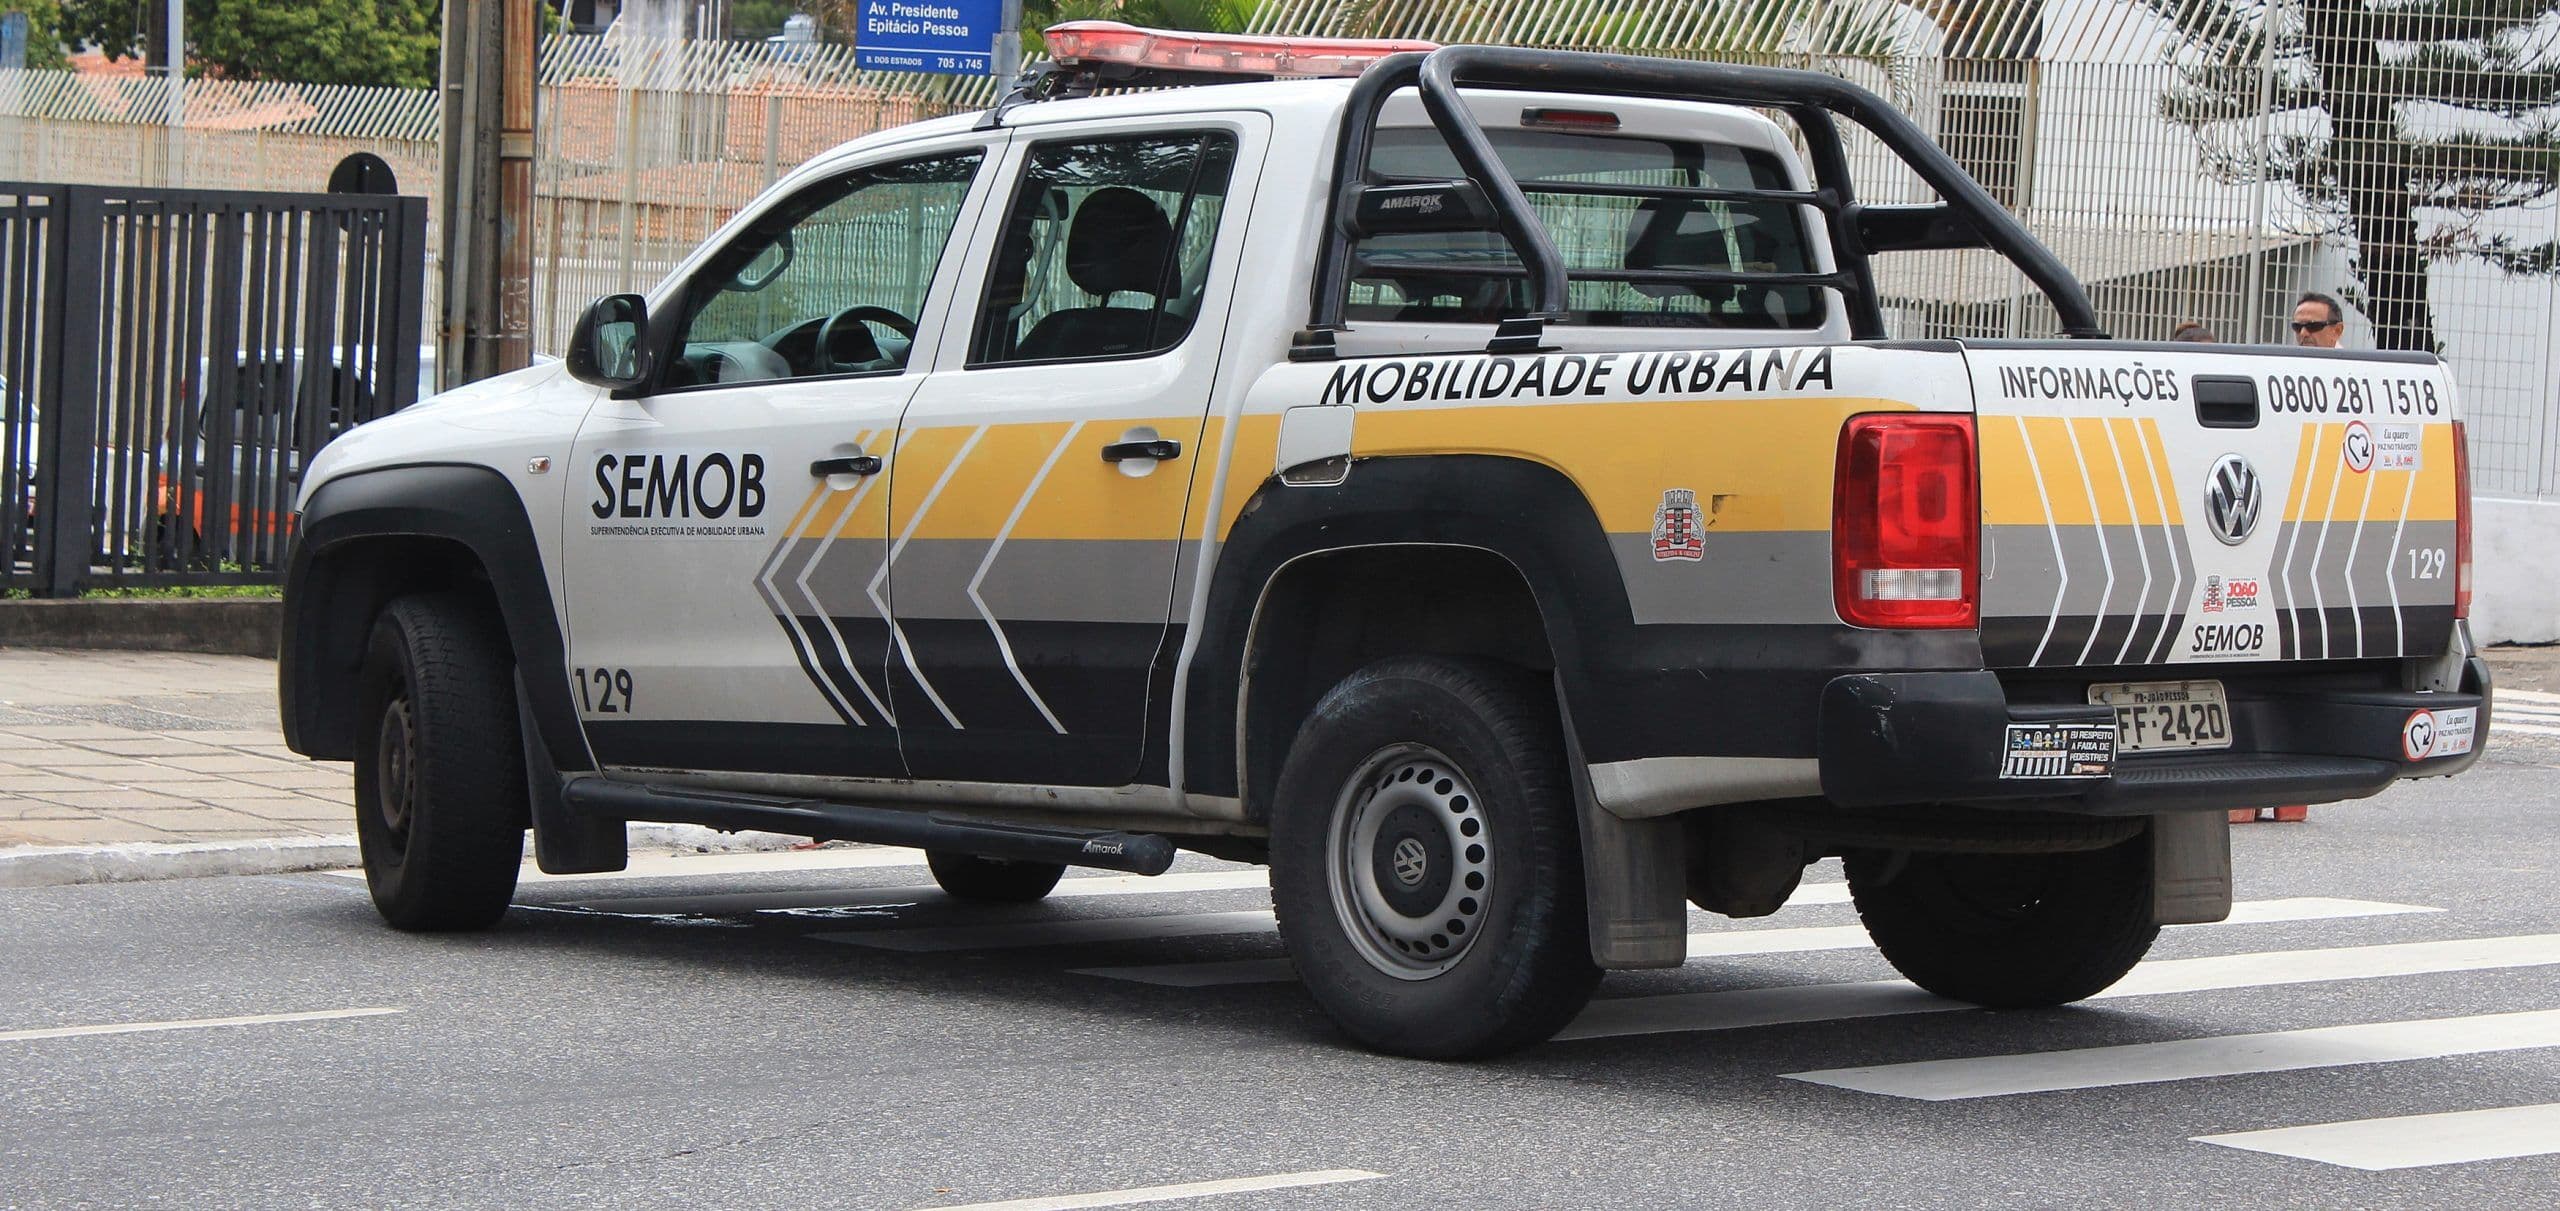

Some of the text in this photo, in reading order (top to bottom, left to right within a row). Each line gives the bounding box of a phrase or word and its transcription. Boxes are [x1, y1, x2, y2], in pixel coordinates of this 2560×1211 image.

[869, 2, 958, 19] Av. Presidente
[868, 18, 968, 36] Epitácio Pessoa
[875, 56, 889, 64] DOS
[891, 57, 922, 65] ESTADOS
[937, 57, 954, 69] 705
[965, 58, 982, 69] 745
[1380, 194, 1443, 209] AMAROK
[1320, 347, 1834, 405] MOBILIDADE URBANA
[1999, 361, 2438, 416] INFORMAÇÕES 0800 281 1518
[591, 453, 766, 519] SEMOB
[590, 525, 765, 536] SUPERINTENDÊNCIA EXECUTIVA DE MOBILIDADE URBANA
[2408, 548, 2445, 579] 129
[2227, 581, 2258, 597] JOÃO
[2226, 597, 2257, 608] PESSOA
[2191, 624, 2264, 652] SEMOB
[575, 668, 633, 713] 129
[2117, 704, 2225, 744] FF-2420
[2079, 731, 2113, 740] RESPEITO
[2070, 753, 2109, 761] PEDESTRES
[1082, 840, 1123, 854] Amarok
